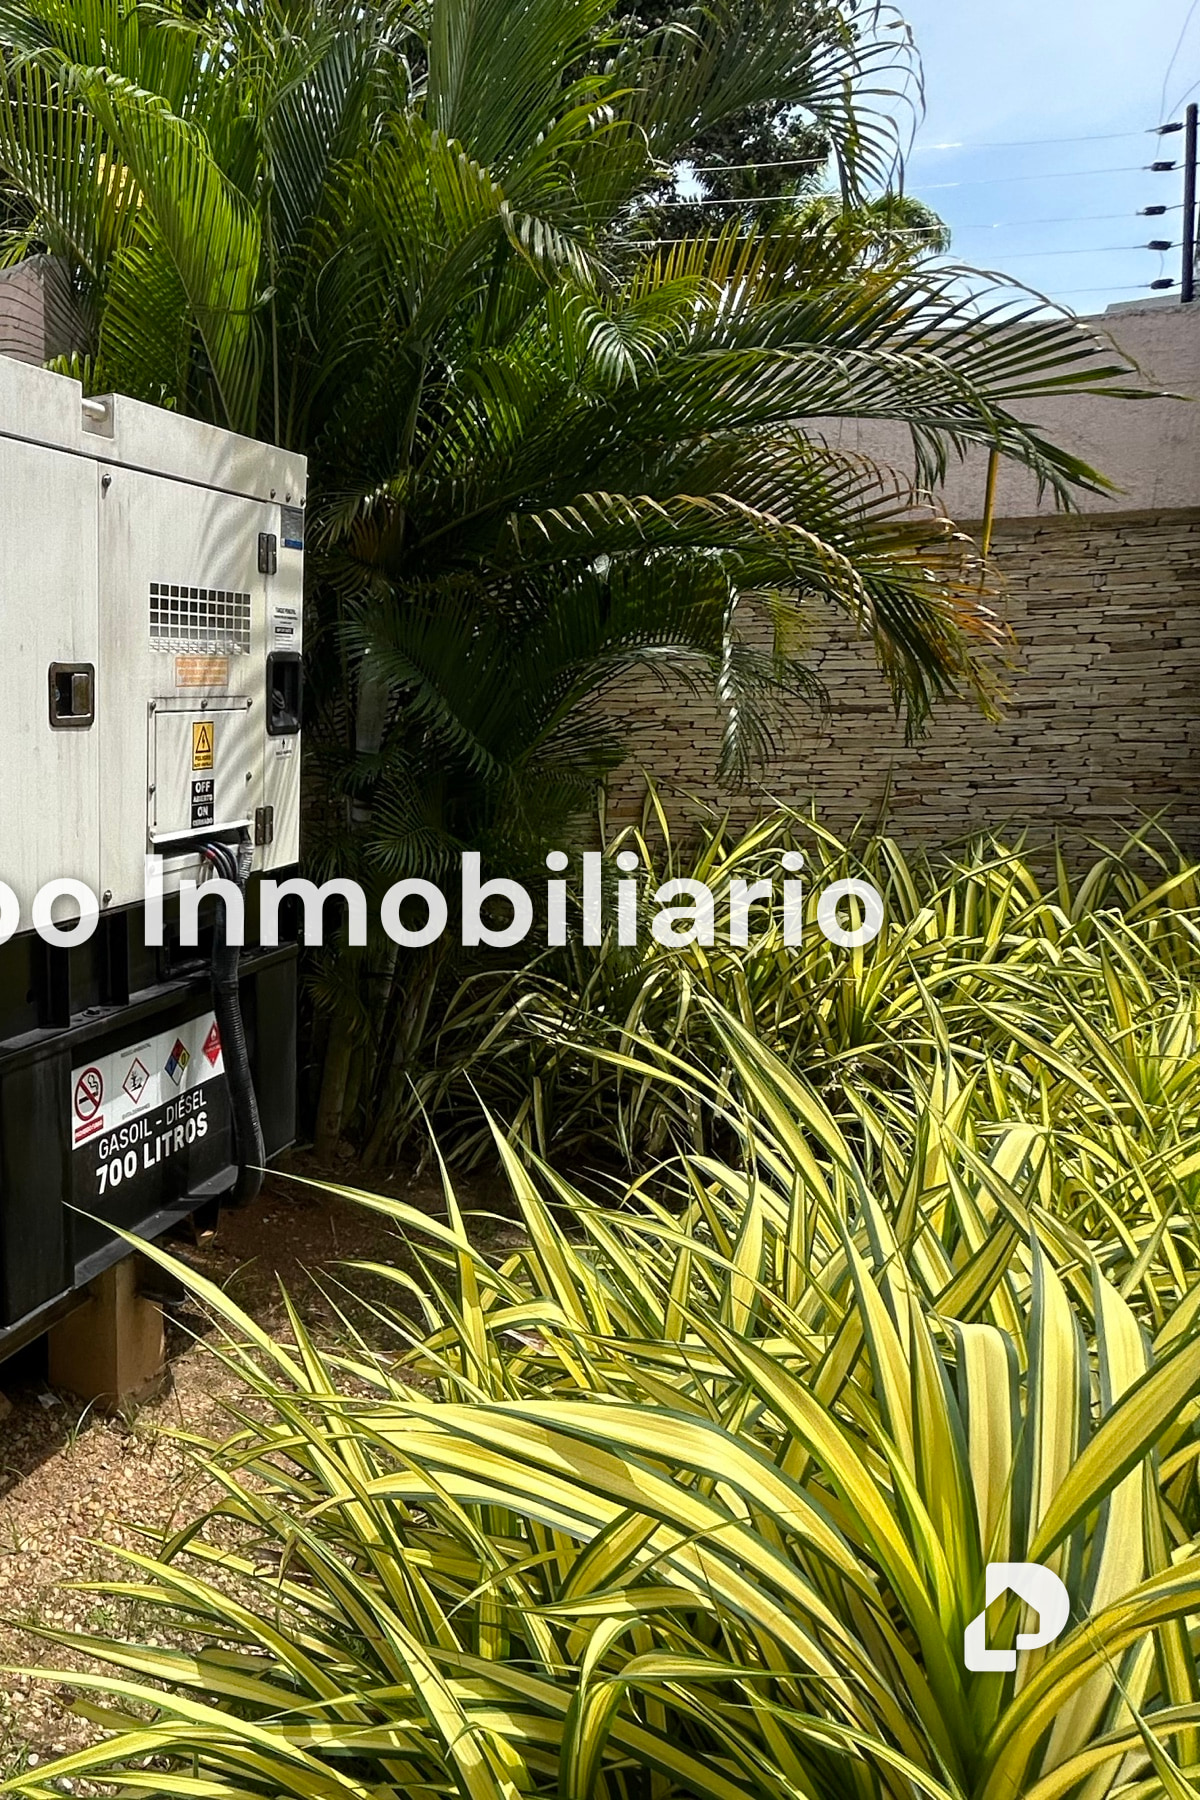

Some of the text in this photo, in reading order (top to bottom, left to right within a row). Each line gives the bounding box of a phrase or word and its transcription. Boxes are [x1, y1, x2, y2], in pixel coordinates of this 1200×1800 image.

[195, 781, 211, 794] OFF
[197, 805, 209, 817] ON
[98, 1117, 153, 1160] GASOIL
[166, 1088, 207, 1126] DIÉSEL
[95, 1111, 209, 1196] 700 LITROS
